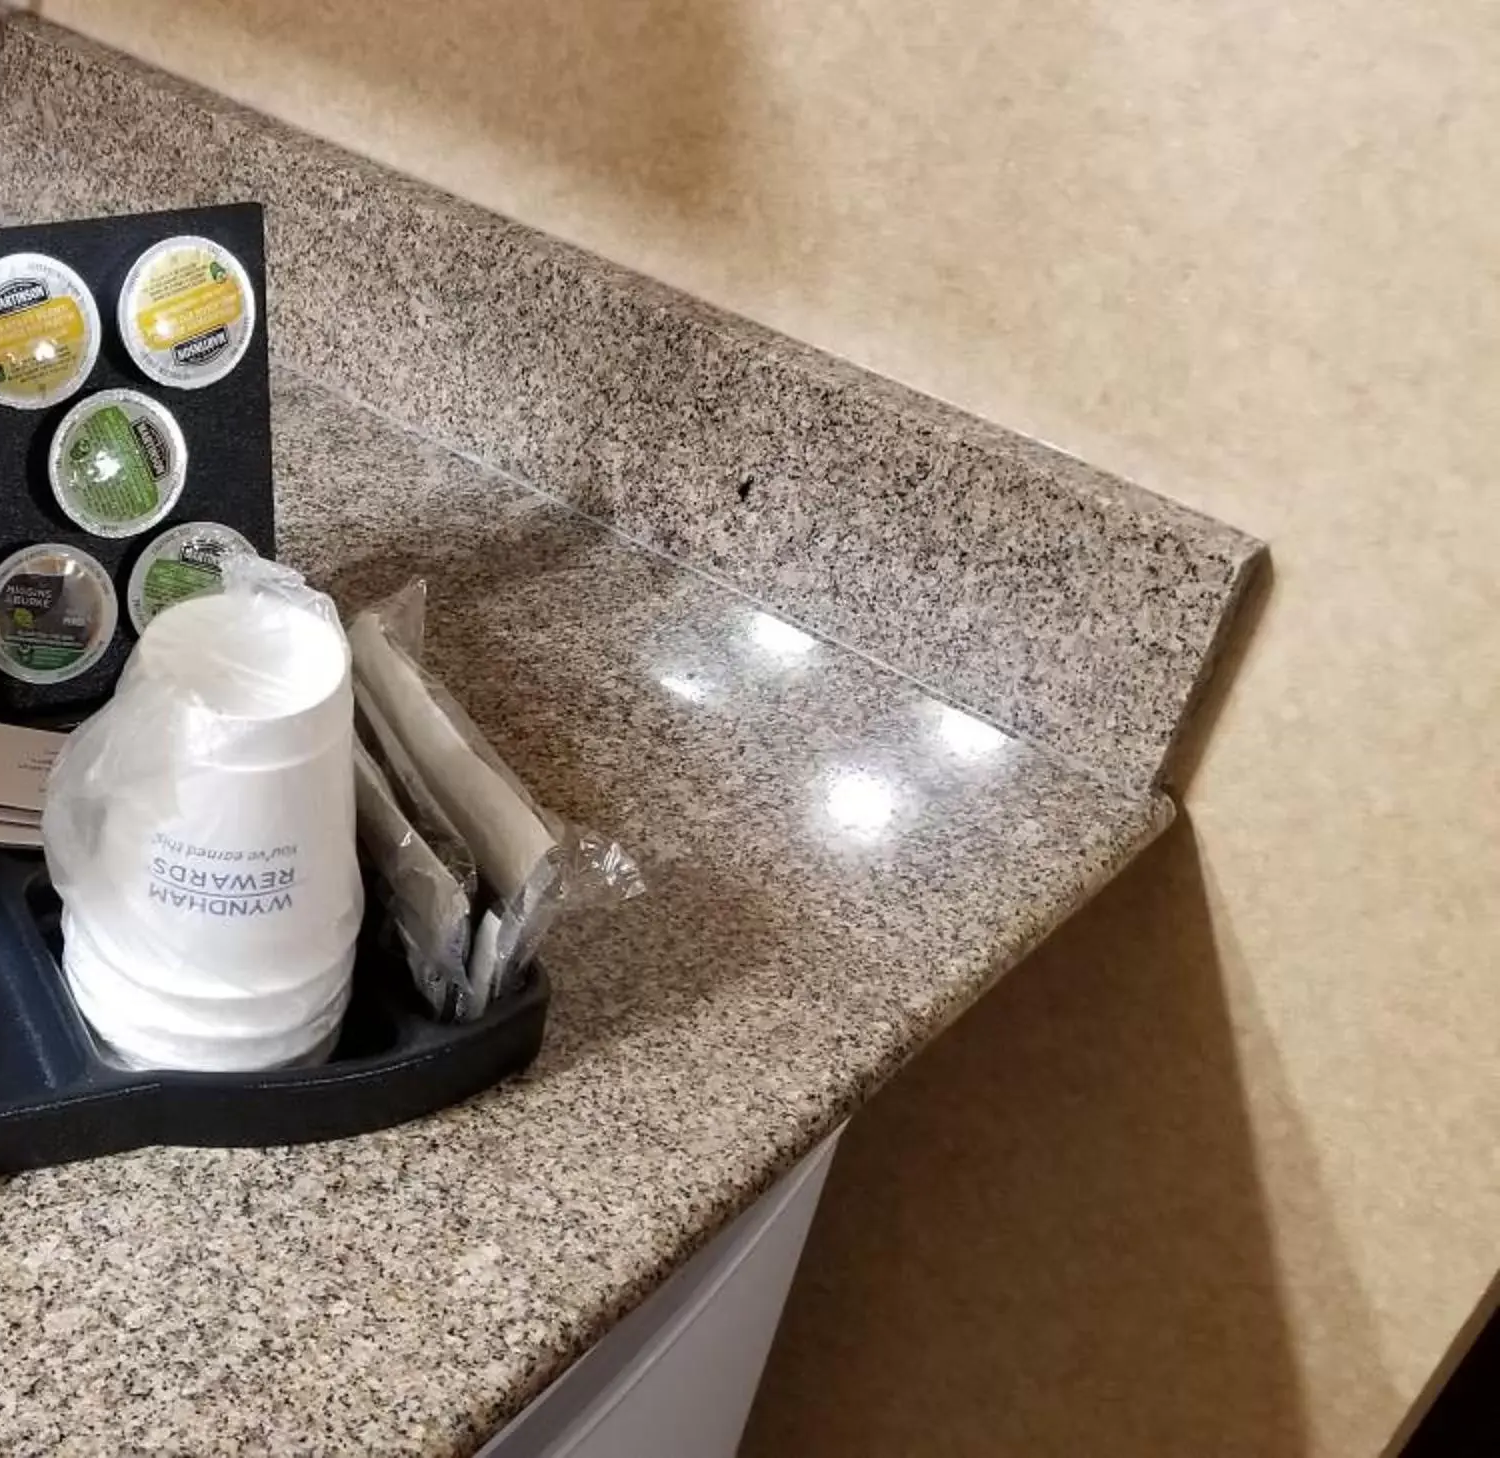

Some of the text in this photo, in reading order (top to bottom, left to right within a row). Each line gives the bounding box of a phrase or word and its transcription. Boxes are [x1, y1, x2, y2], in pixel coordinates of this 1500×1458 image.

[186, 844, 242, 862] earned
[246, 844, 298, 862] You've
[152, 856, 295, 891] REWARDS
[148, 882, 293, 916] WYNDHAM
